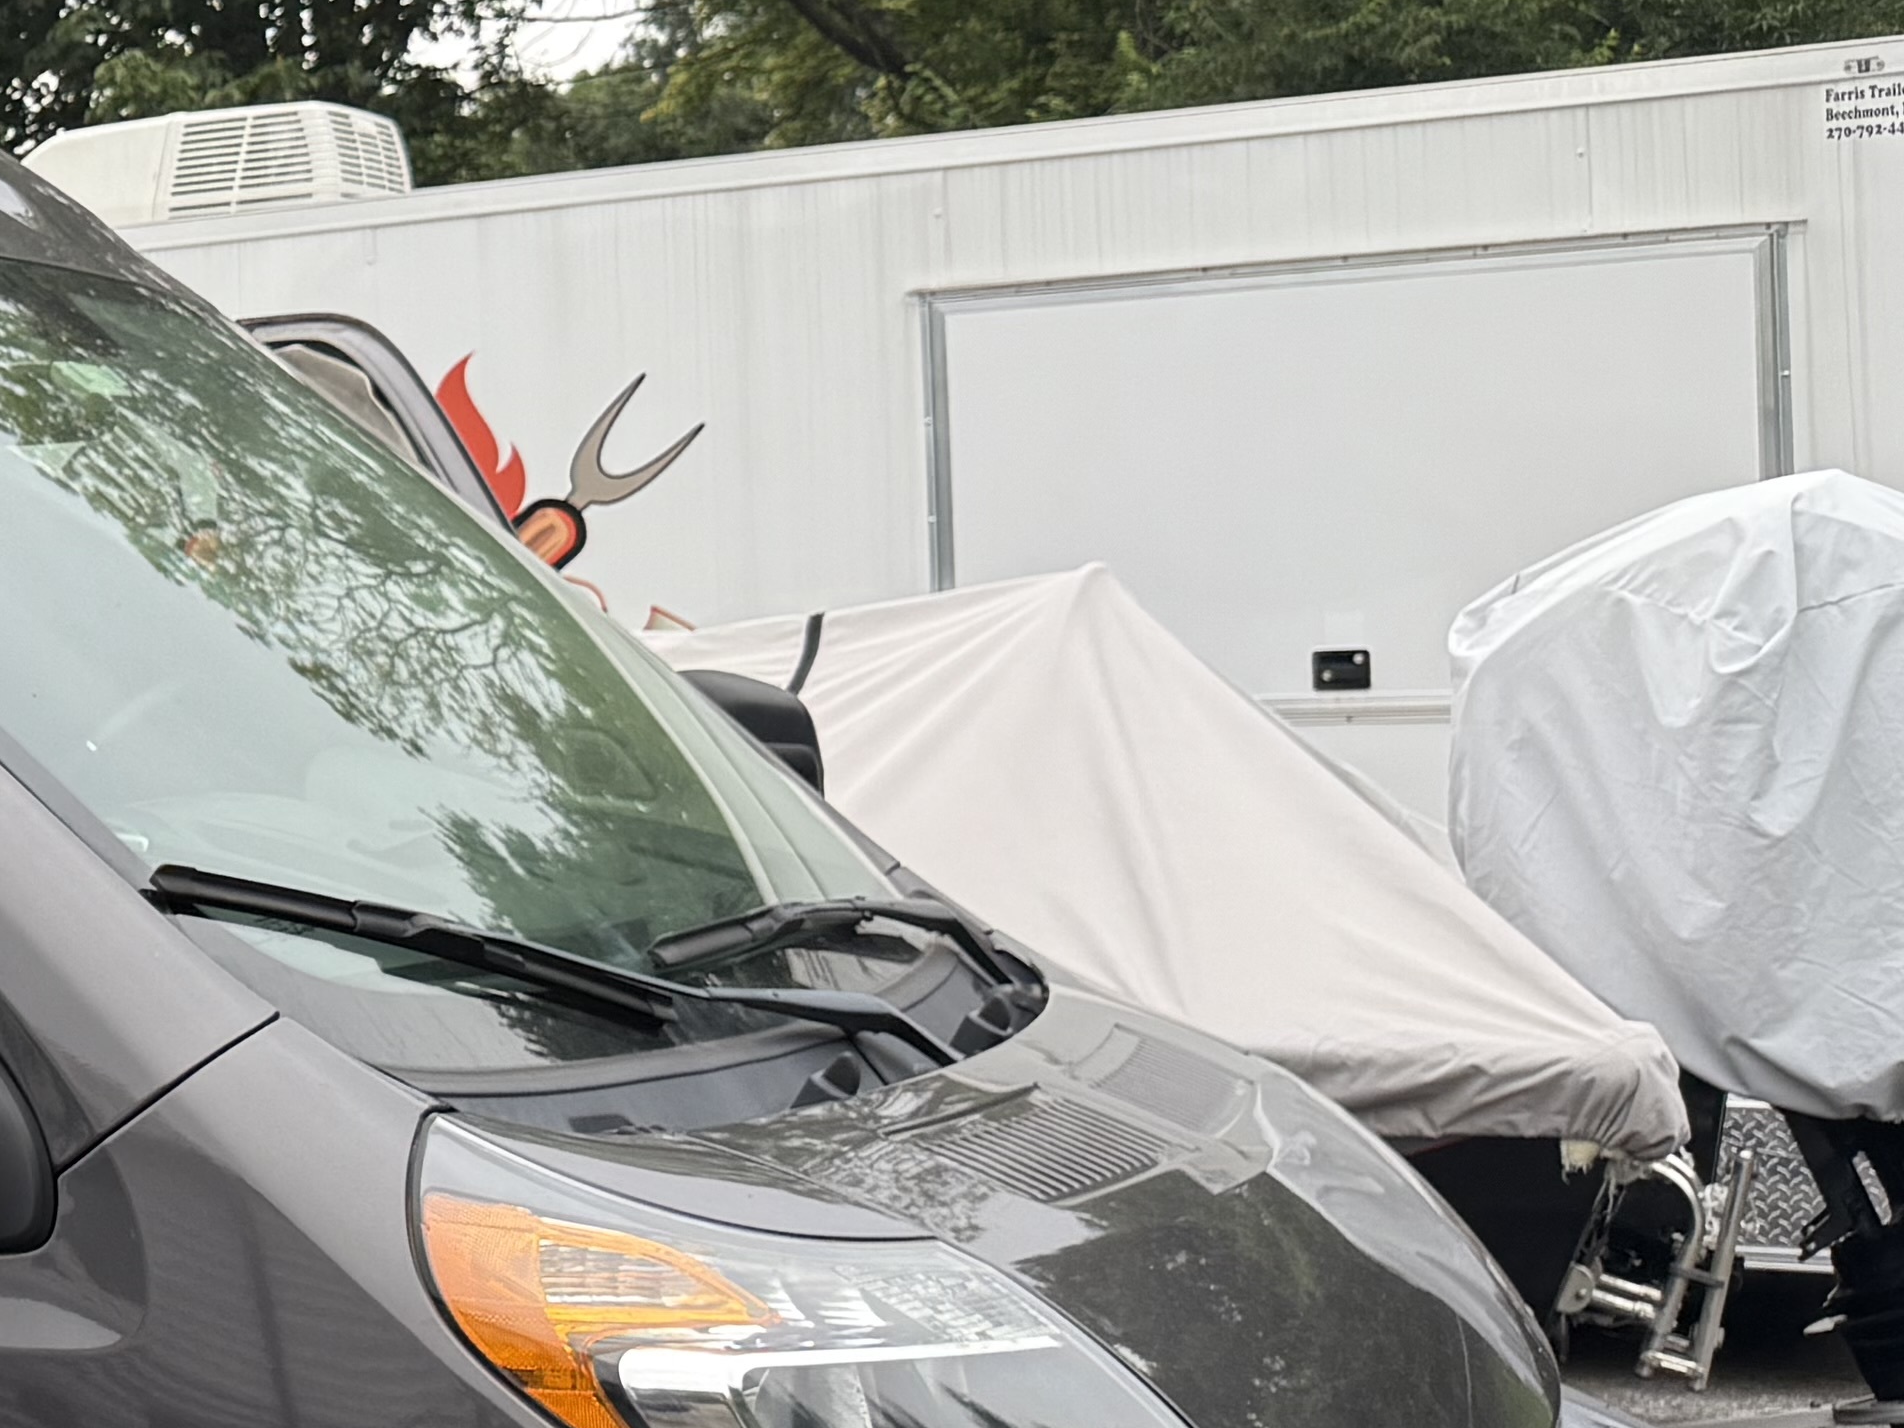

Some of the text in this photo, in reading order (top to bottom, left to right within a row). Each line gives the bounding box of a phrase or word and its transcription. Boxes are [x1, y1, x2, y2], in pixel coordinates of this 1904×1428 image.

[1825, 82, 1904, 103] Farris Trail
[1825, 104, 1899, 122] Beechmont,
